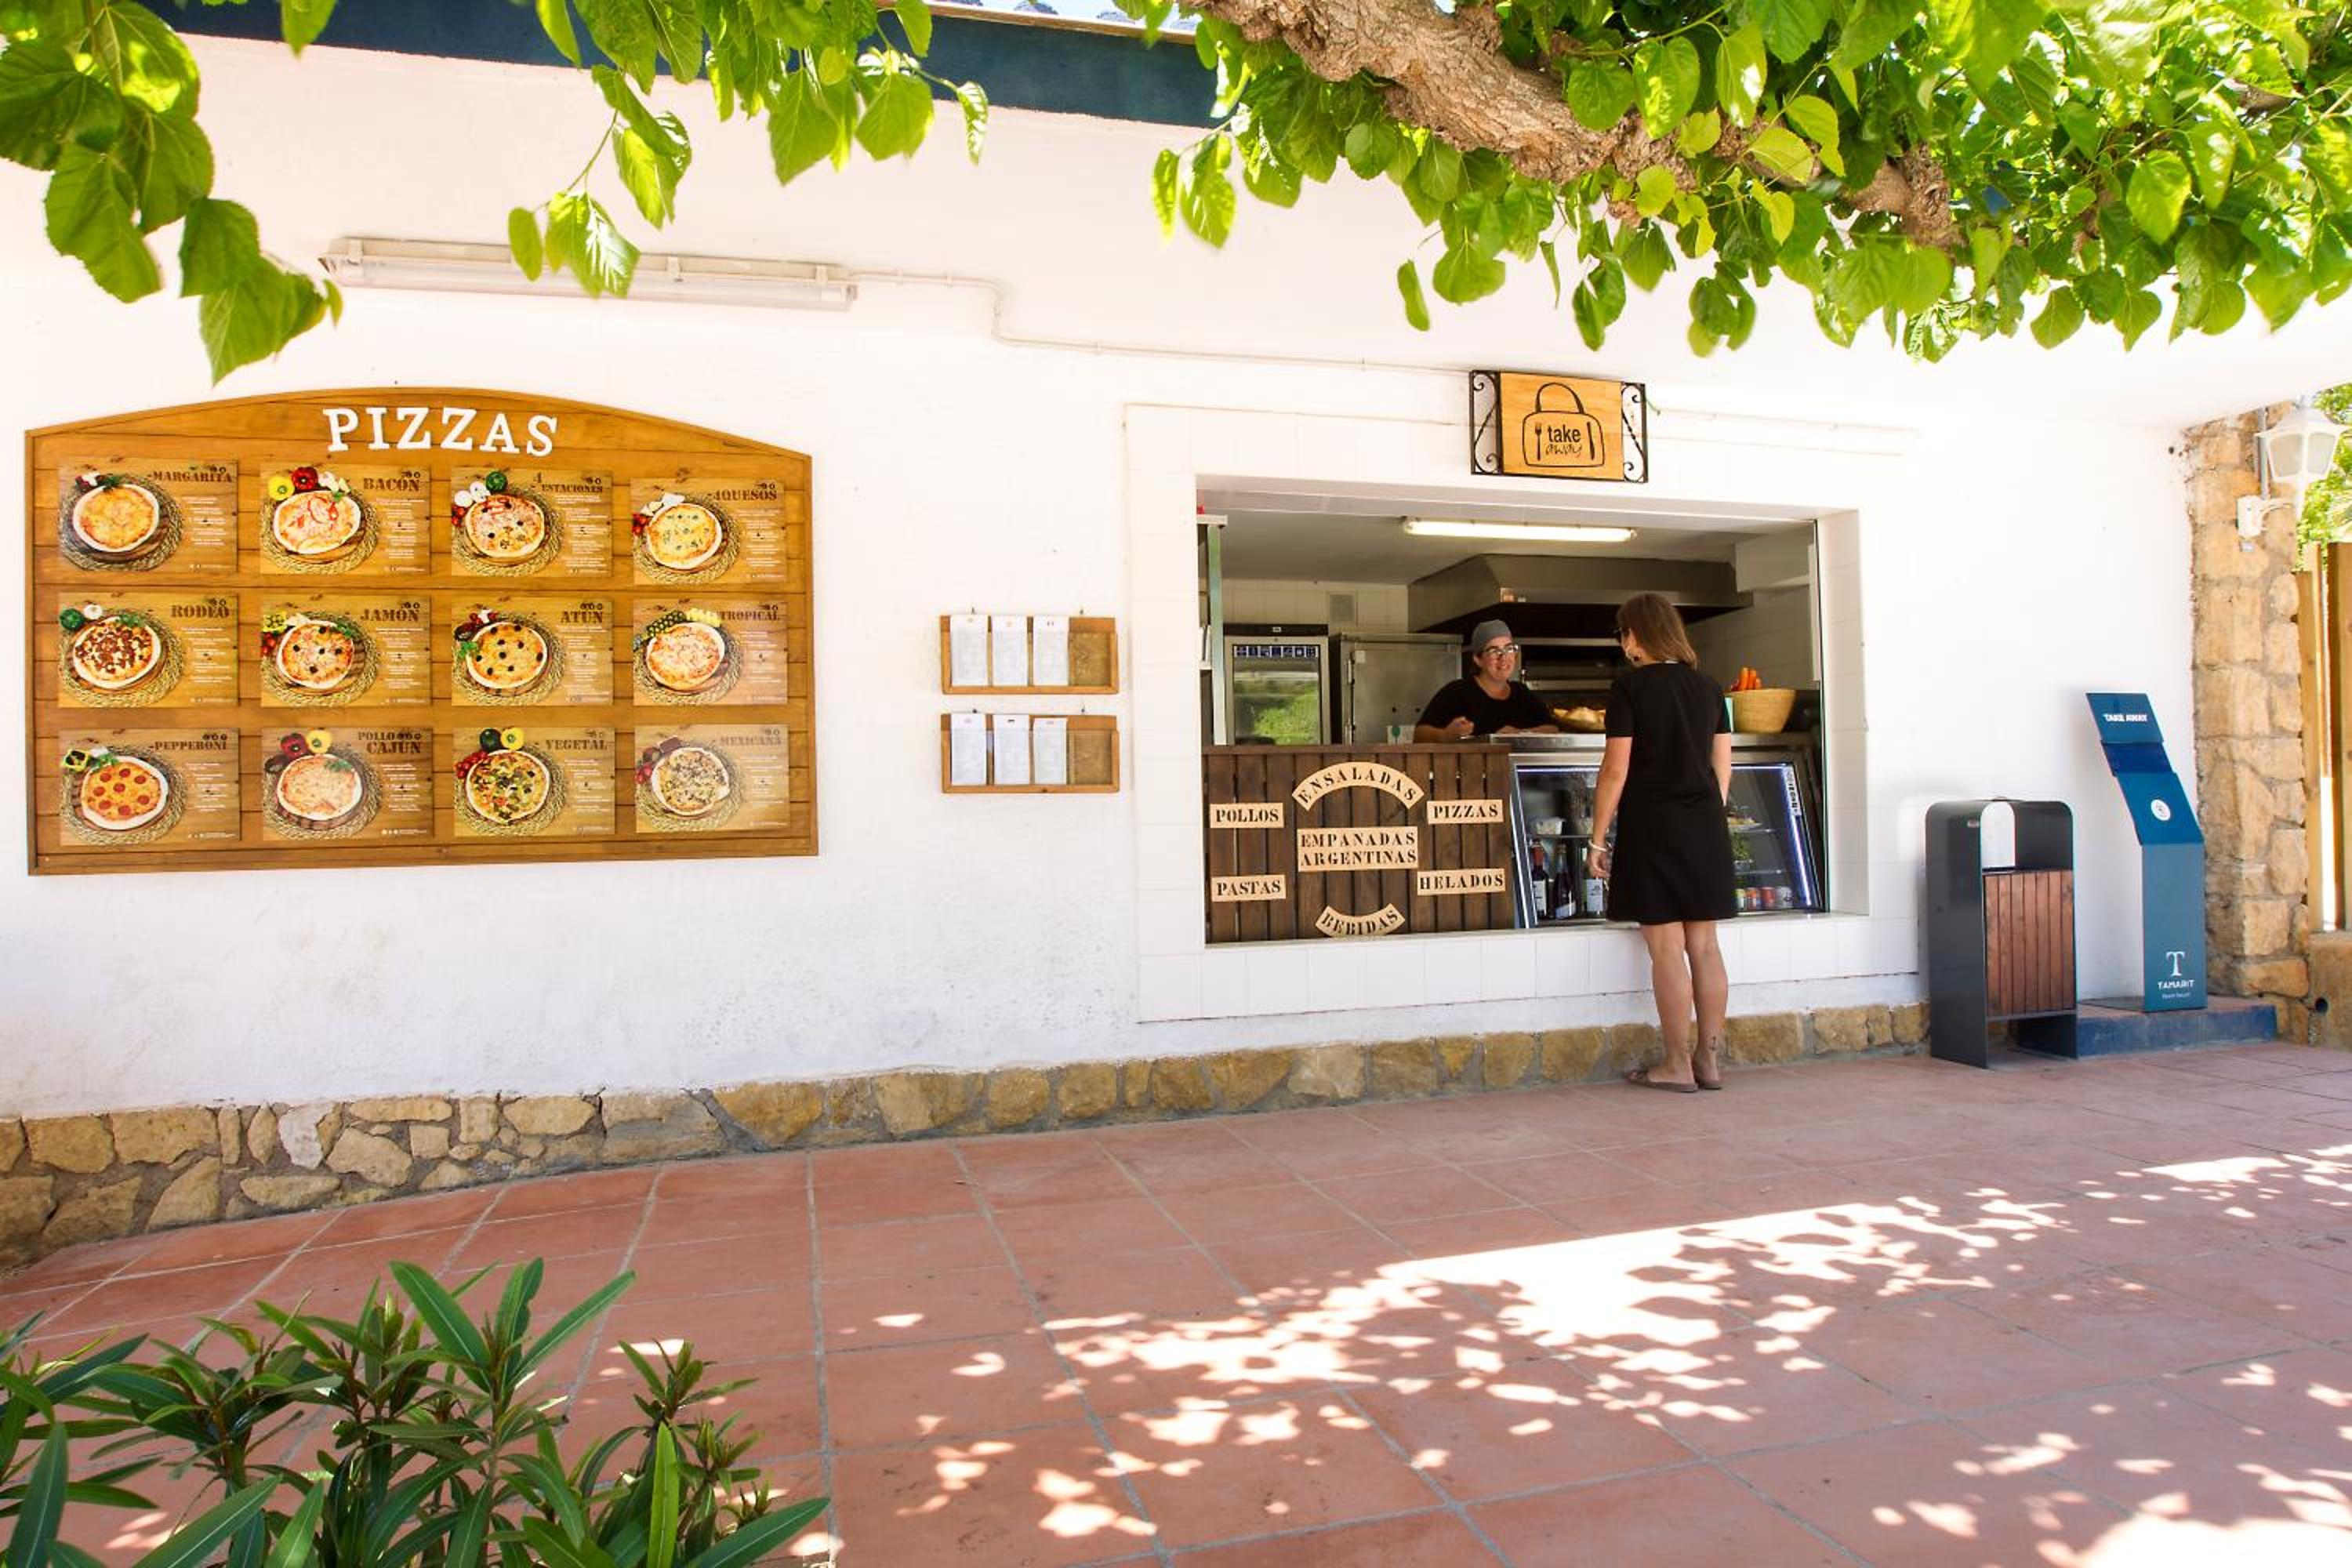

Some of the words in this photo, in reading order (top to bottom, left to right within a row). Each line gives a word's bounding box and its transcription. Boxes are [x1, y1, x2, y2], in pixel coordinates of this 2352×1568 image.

[322, 406, 557, 457] PIZZAS
[1547, 423, 1581, 443] take
[153, 470, 232, 483] MARGARITA
[363, 477, 419, 492] BACON
[542, 484, 603, 493] ESTACIONES
[171, 604, 230, 618] RODEO
[717, 611, 779, 621] TROPICAL
[154, 741, 227, 750] PEPPERONI
[366, 741, 421, 754] CAJUN
[545, 739, 608, 750] VEGETAL
[1298, 766, 1417, 805] ENSALADAS
[1215, 808, 1279, 822] POLLOS
[1433, 804, 1498, 819] PIZZAS
[1301, 832, 1416, 848] EMPANADAS
[1300, 849, 1417, 866] ARGENTINAS
[1216, 879, 1281, 896] PASTAS
[1419, 874, 1504, 891] HELADOS
[1320, 909, 1399, 935] BEBIDAS
[2166, 951, 2185, 977] T
[2157, 979, 2195, 990] TAMARIT
